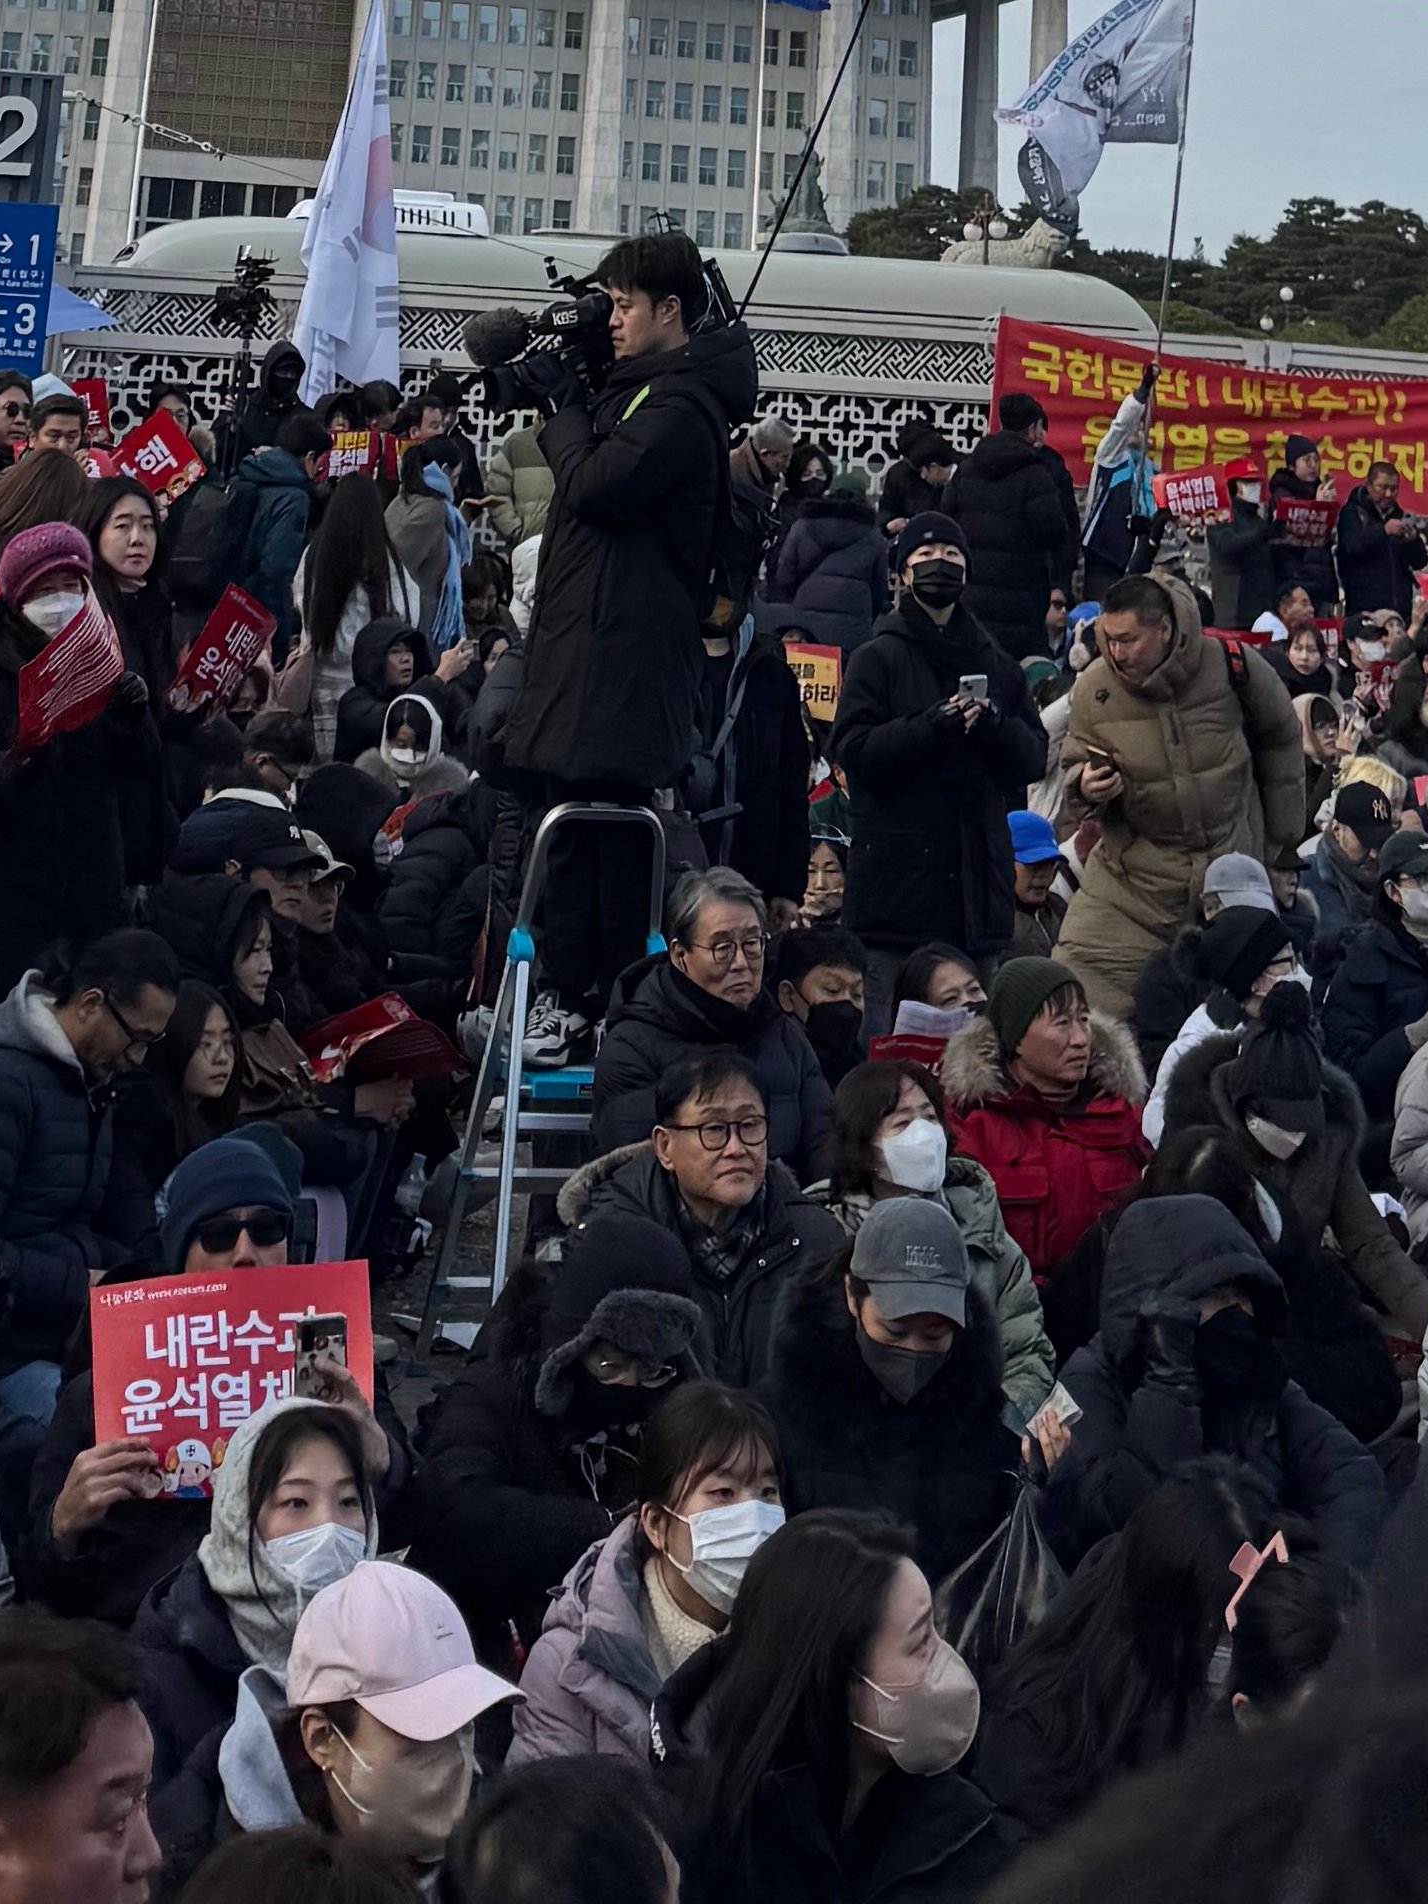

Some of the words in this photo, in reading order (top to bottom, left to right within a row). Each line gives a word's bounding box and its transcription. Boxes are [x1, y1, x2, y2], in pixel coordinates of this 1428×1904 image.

[29, 234, 40, 266] 1
[14, 302, 37, 336] 3
[121, 1370, 252, 1435] 윤석열
